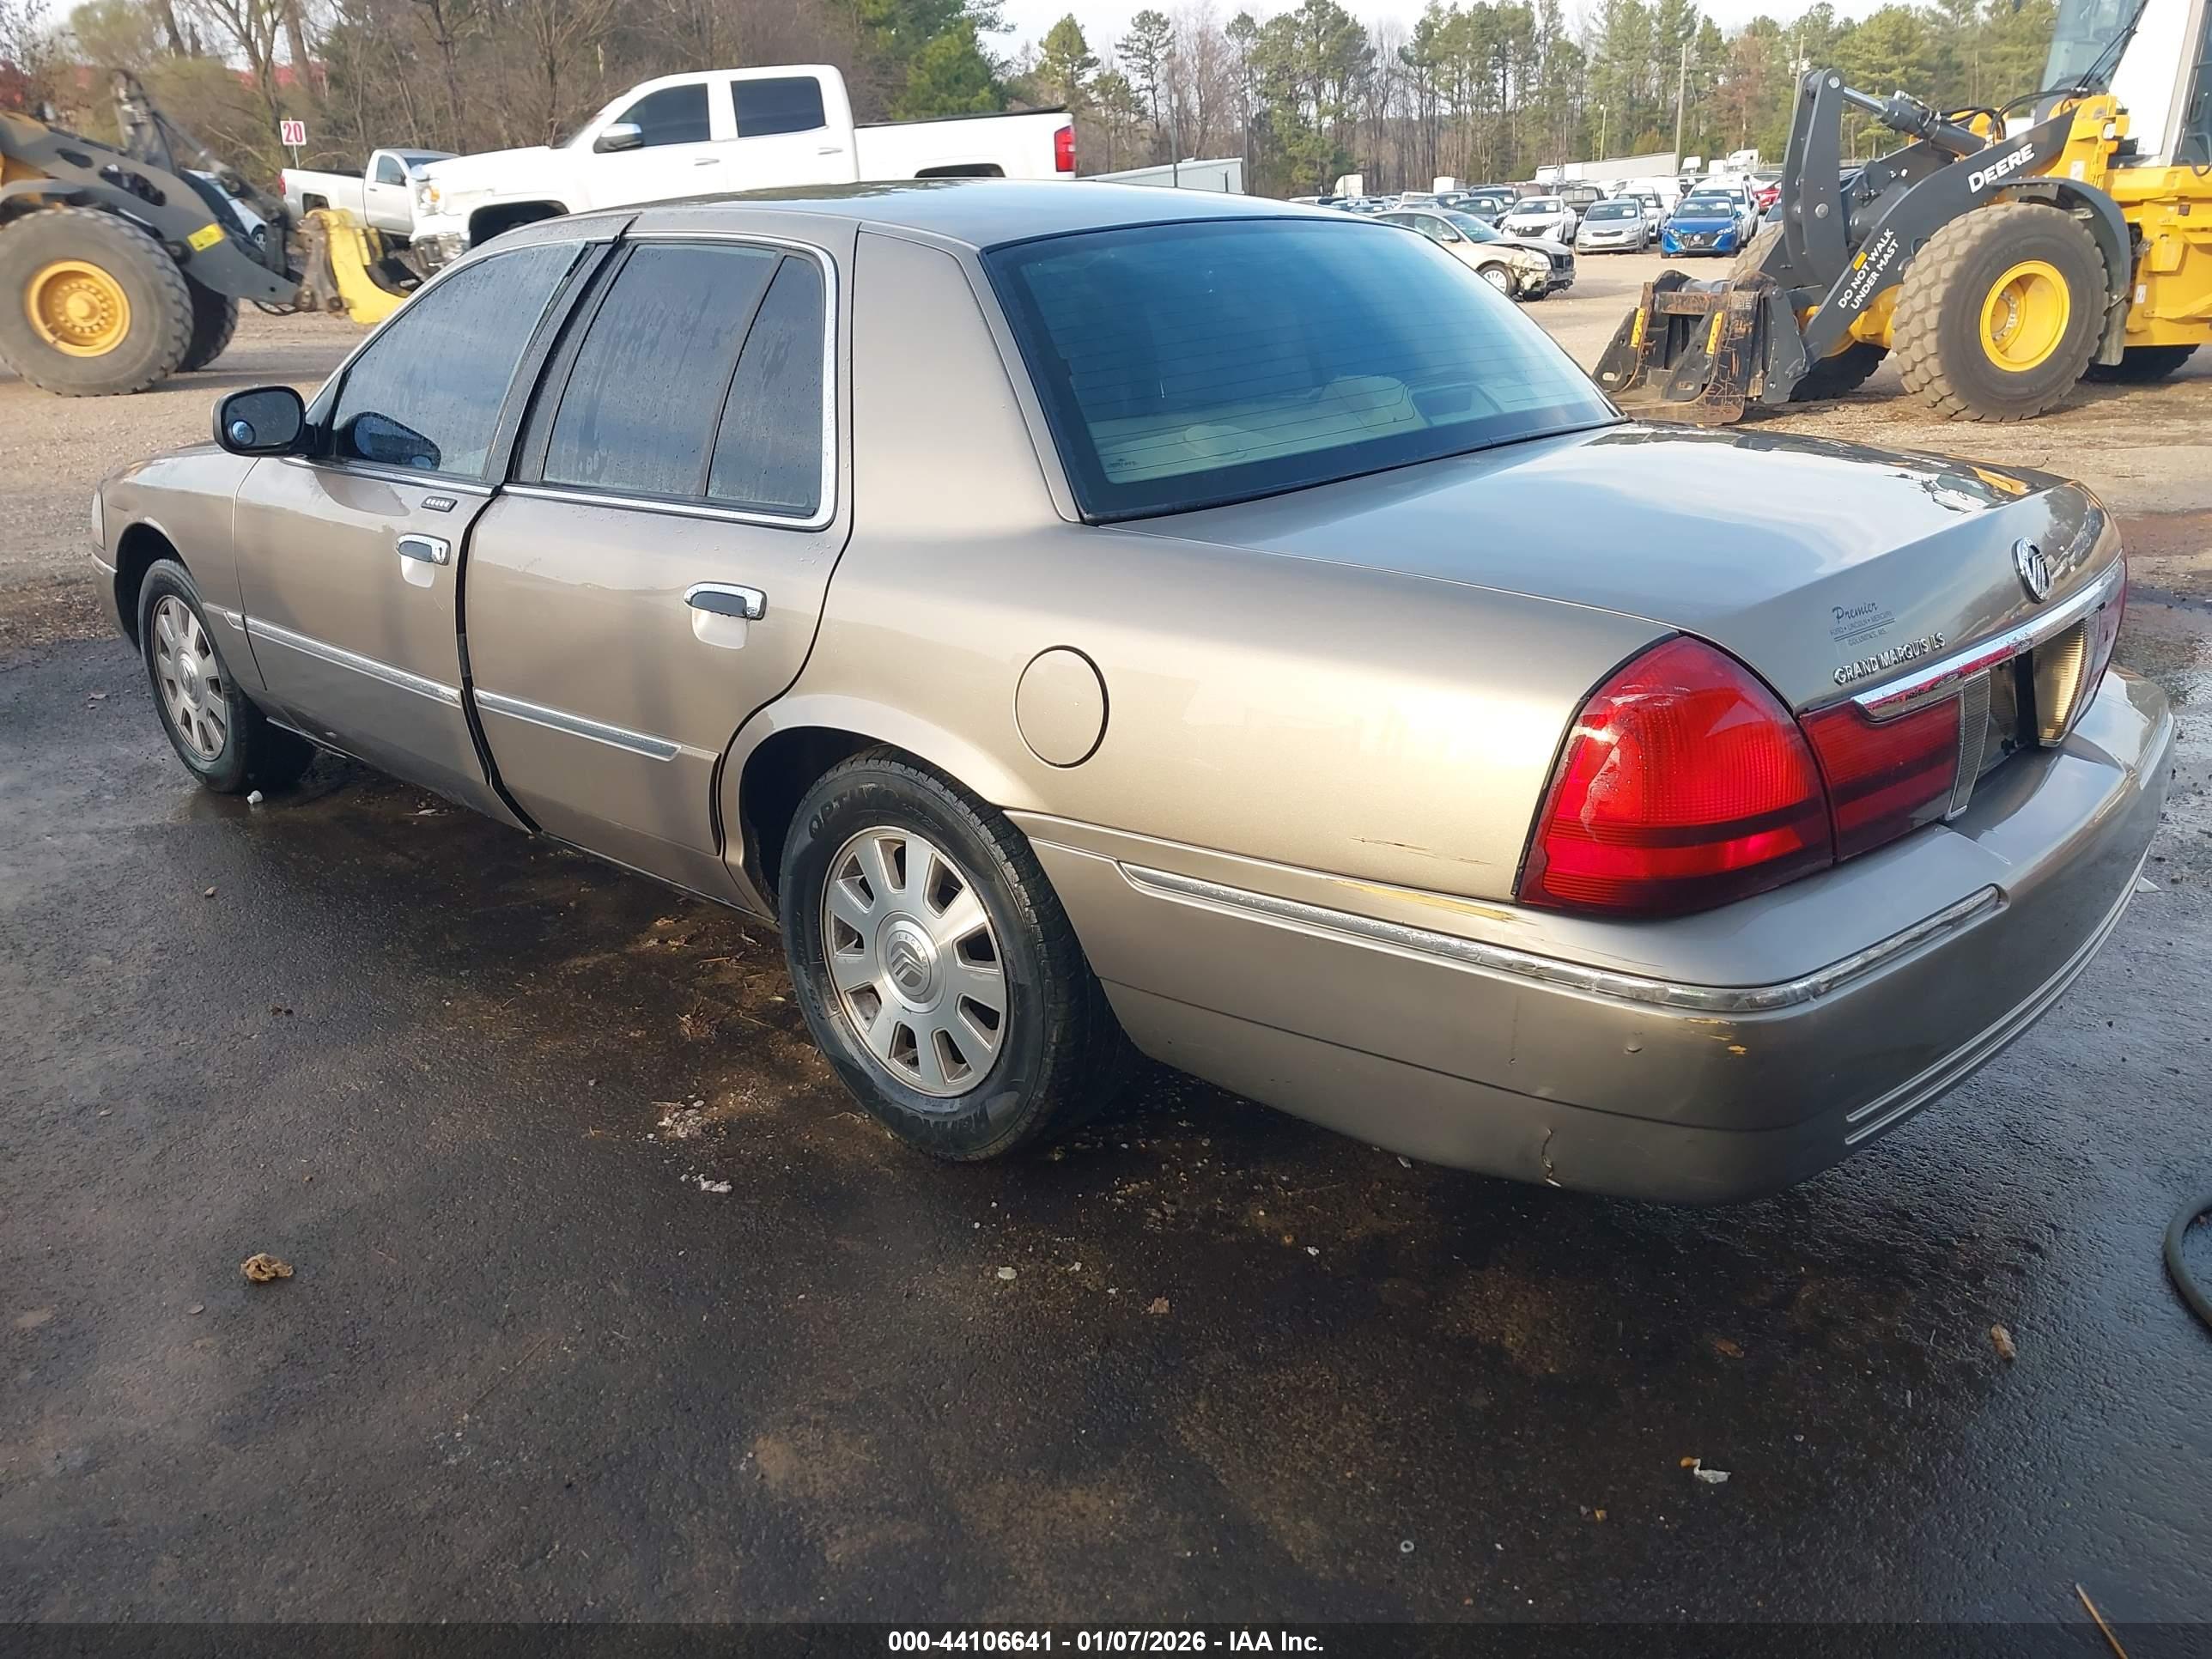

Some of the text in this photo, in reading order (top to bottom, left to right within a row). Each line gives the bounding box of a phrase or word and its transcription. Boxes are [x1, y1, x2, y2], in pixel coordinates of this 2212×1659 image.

[283, 123, 303, 143] 20
[1967, 143, 2035, 194] DEERE
[1838, 228, 1894, 308] DO NOT WALK
[1850, 239, 1899, 309] UNDER MAST
[1832, 601, 1879, 623] Premier
[1833, 632, 1946, 685] GRAND MARQUIS LS
